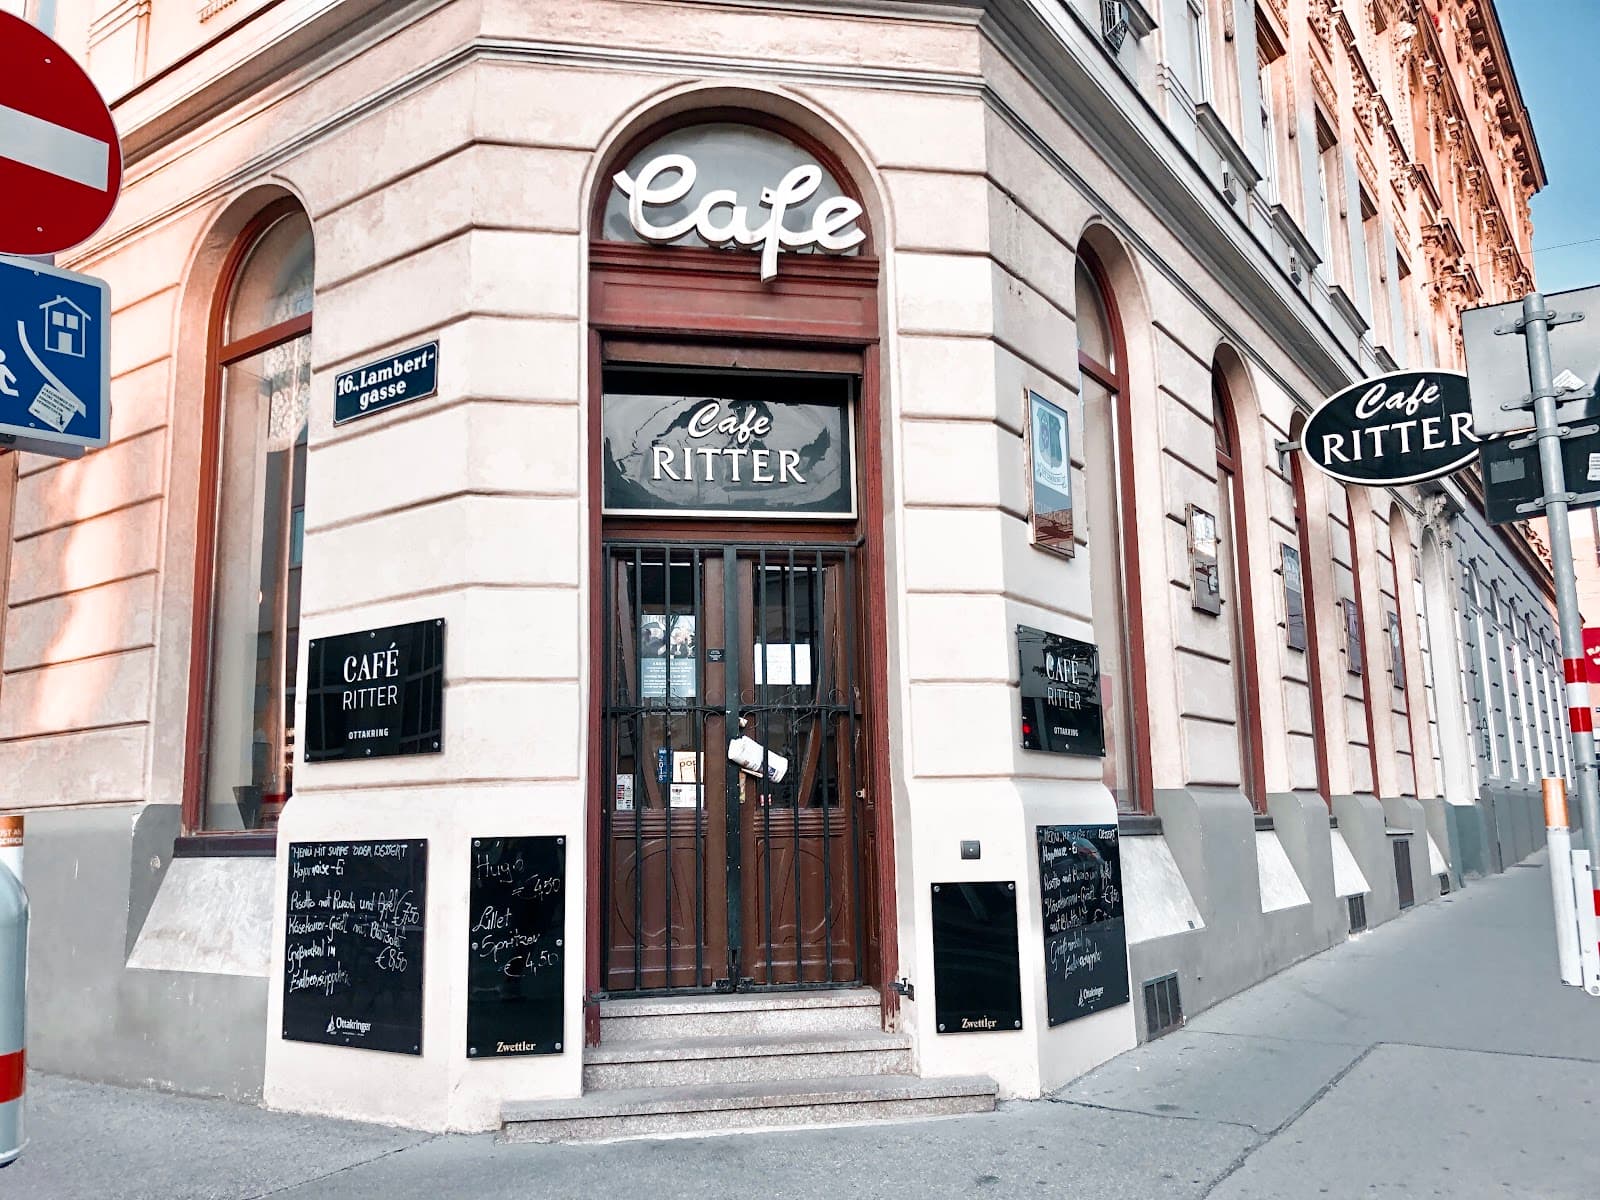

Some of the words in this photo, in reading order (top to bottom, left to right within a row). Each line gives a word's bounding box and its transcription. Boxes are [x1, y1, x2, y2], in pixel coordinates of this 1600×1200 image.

[613, 154, 867, 283] Cafe
[360, 350, 435, 389] Lambert-
[360, 380, 407, 411] gasse
[1355, 378, 1440, 420] Cafe
[688, 402, 772, 443] Cafe
[1322, 412, 1483, 466] RITTER
[652, 446, 806, 484] RITTER
[343, 641, 399, 683] CAFÉ
[1046, 653, 1080, 685] CAFÉ
[343, 685, 398, 711] RITTER
[1047, 687, 1081, 710] RITTER
[348, 728, 389, 740] OTTAKRING
[476, 854, 525, 884] Hugo
[359, 891, 375, 912] und
[472, 905, 513, 932] Lillet
[336, 1017, 372, 1033] Ottakringer
[962, 1014, 997, 1029] Zwettler
[496, 1041, 537, 1052] Zwettler
